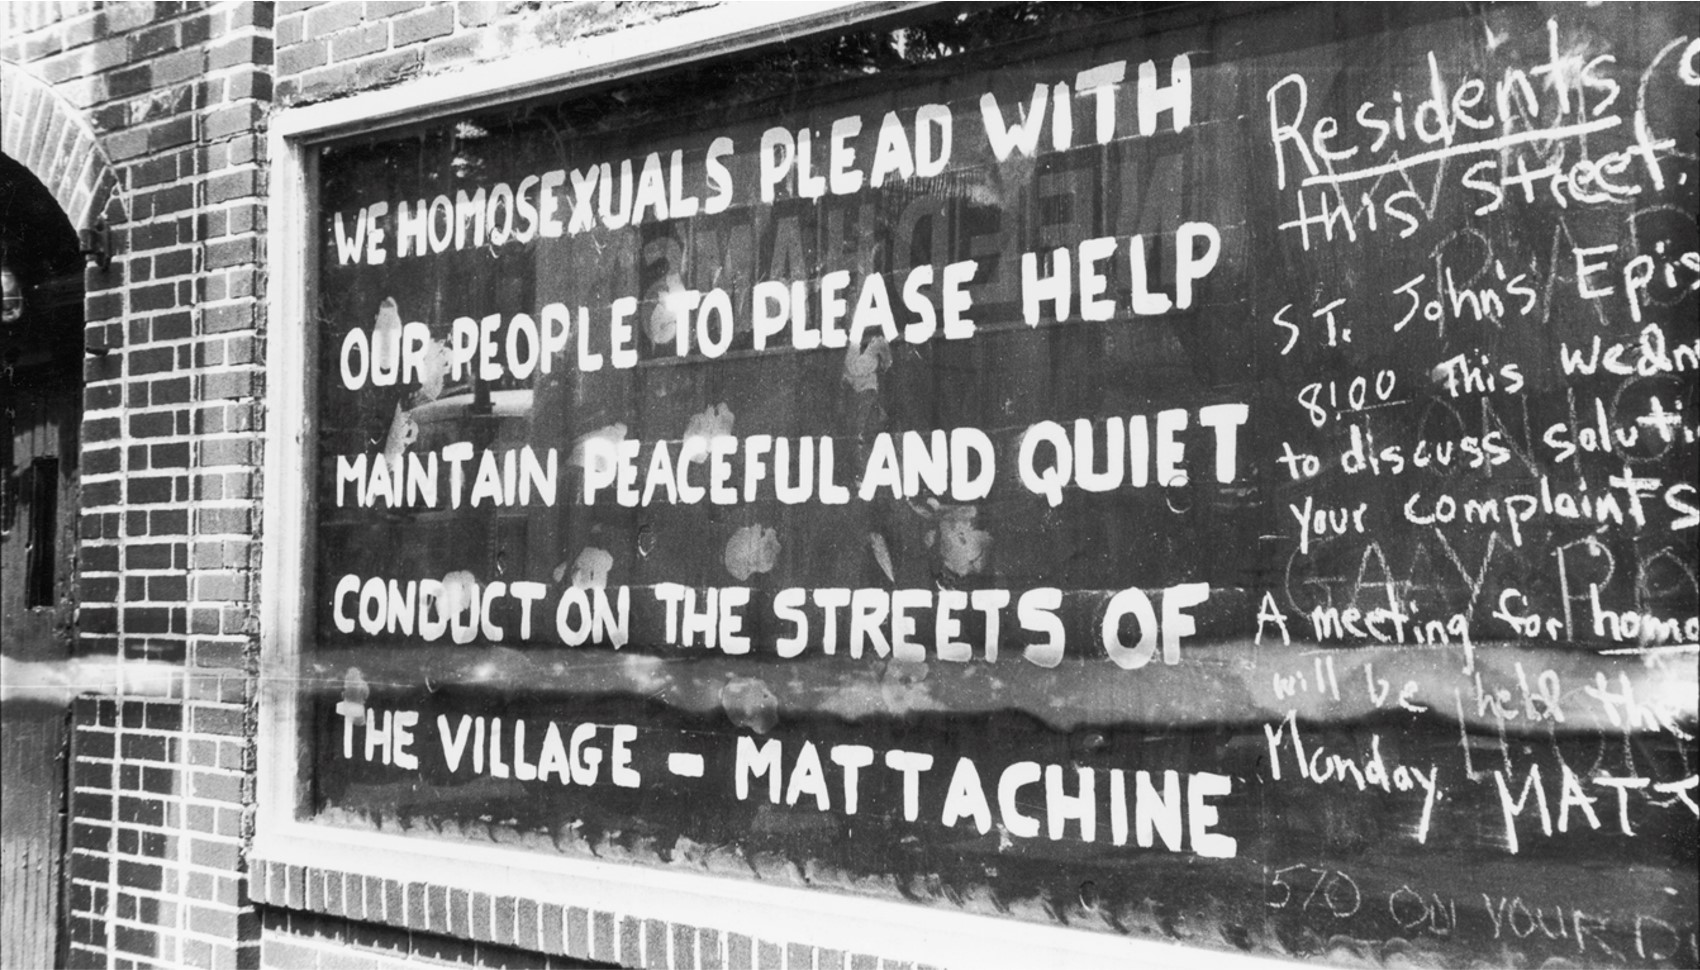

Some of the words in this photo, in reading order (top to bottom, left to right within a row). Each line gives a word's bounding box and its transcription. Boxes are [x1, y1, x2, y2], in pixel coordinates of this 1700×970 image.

[1267, 18, 1621, 190] Residents
[334, 201, 389, 266] WE
[398, 136, 735, 258] HOMOSEXUALS
[760, 103, 953, 203] PLEAD
[979, 53, 1192, 162] WITH
[1278, 190, 1419, 250] this
[340, 321, 433, 390] OUR
[450, 296, 639, 382] PEOPLE
[667, 287, 734, 358] TO
[752, 260, 978, 350] PLEASE
[1021, 221, 1222, 328] HELP
[1393, 259, 1537, 332] John's
[337, 441, 558, 509] MAINTAIN
[583, 434, 850, 507] PEACEFUL
[858, 427, 996, 501] AND
[1018, 403, 1249, 508] QUIET
[1277, 442, 1320, 480] to
[1342, 424, 1511, 476] discuss
[1543, 395, 1698, 464] soluti
[333, 574, 547, 645] CONDUCT
[556, 584, 630, 650] ON
[655, 582, 751, 655] THE
[773, 586, 1066, 668] STREETS
[1102, 581, 1210, 669] OF
[1255, 591, 1290, 646] A
[1312, 585, 1475, 676] meeting
[1492, 587, 1564, 641] for
[1273, 655, 1341, 701] will
[1363, 662, 1429, 713] be
[1475, 661, 1565, 723] held
[336, 701, 419, 769] THE
[437, 714, 641, 788] VILLAGE
[668, 752, 705, 778] -
[735, 736, 1237, 858] MATTACHINE
[1264, 709, 1444, 845] Monday.
[1494, 764, 1698, 855] MATT
[1265, 863, 1361, 918] 570
[1388, 884, 1457, 935] ON
[1481, 892, 1627, 962] YOUR
